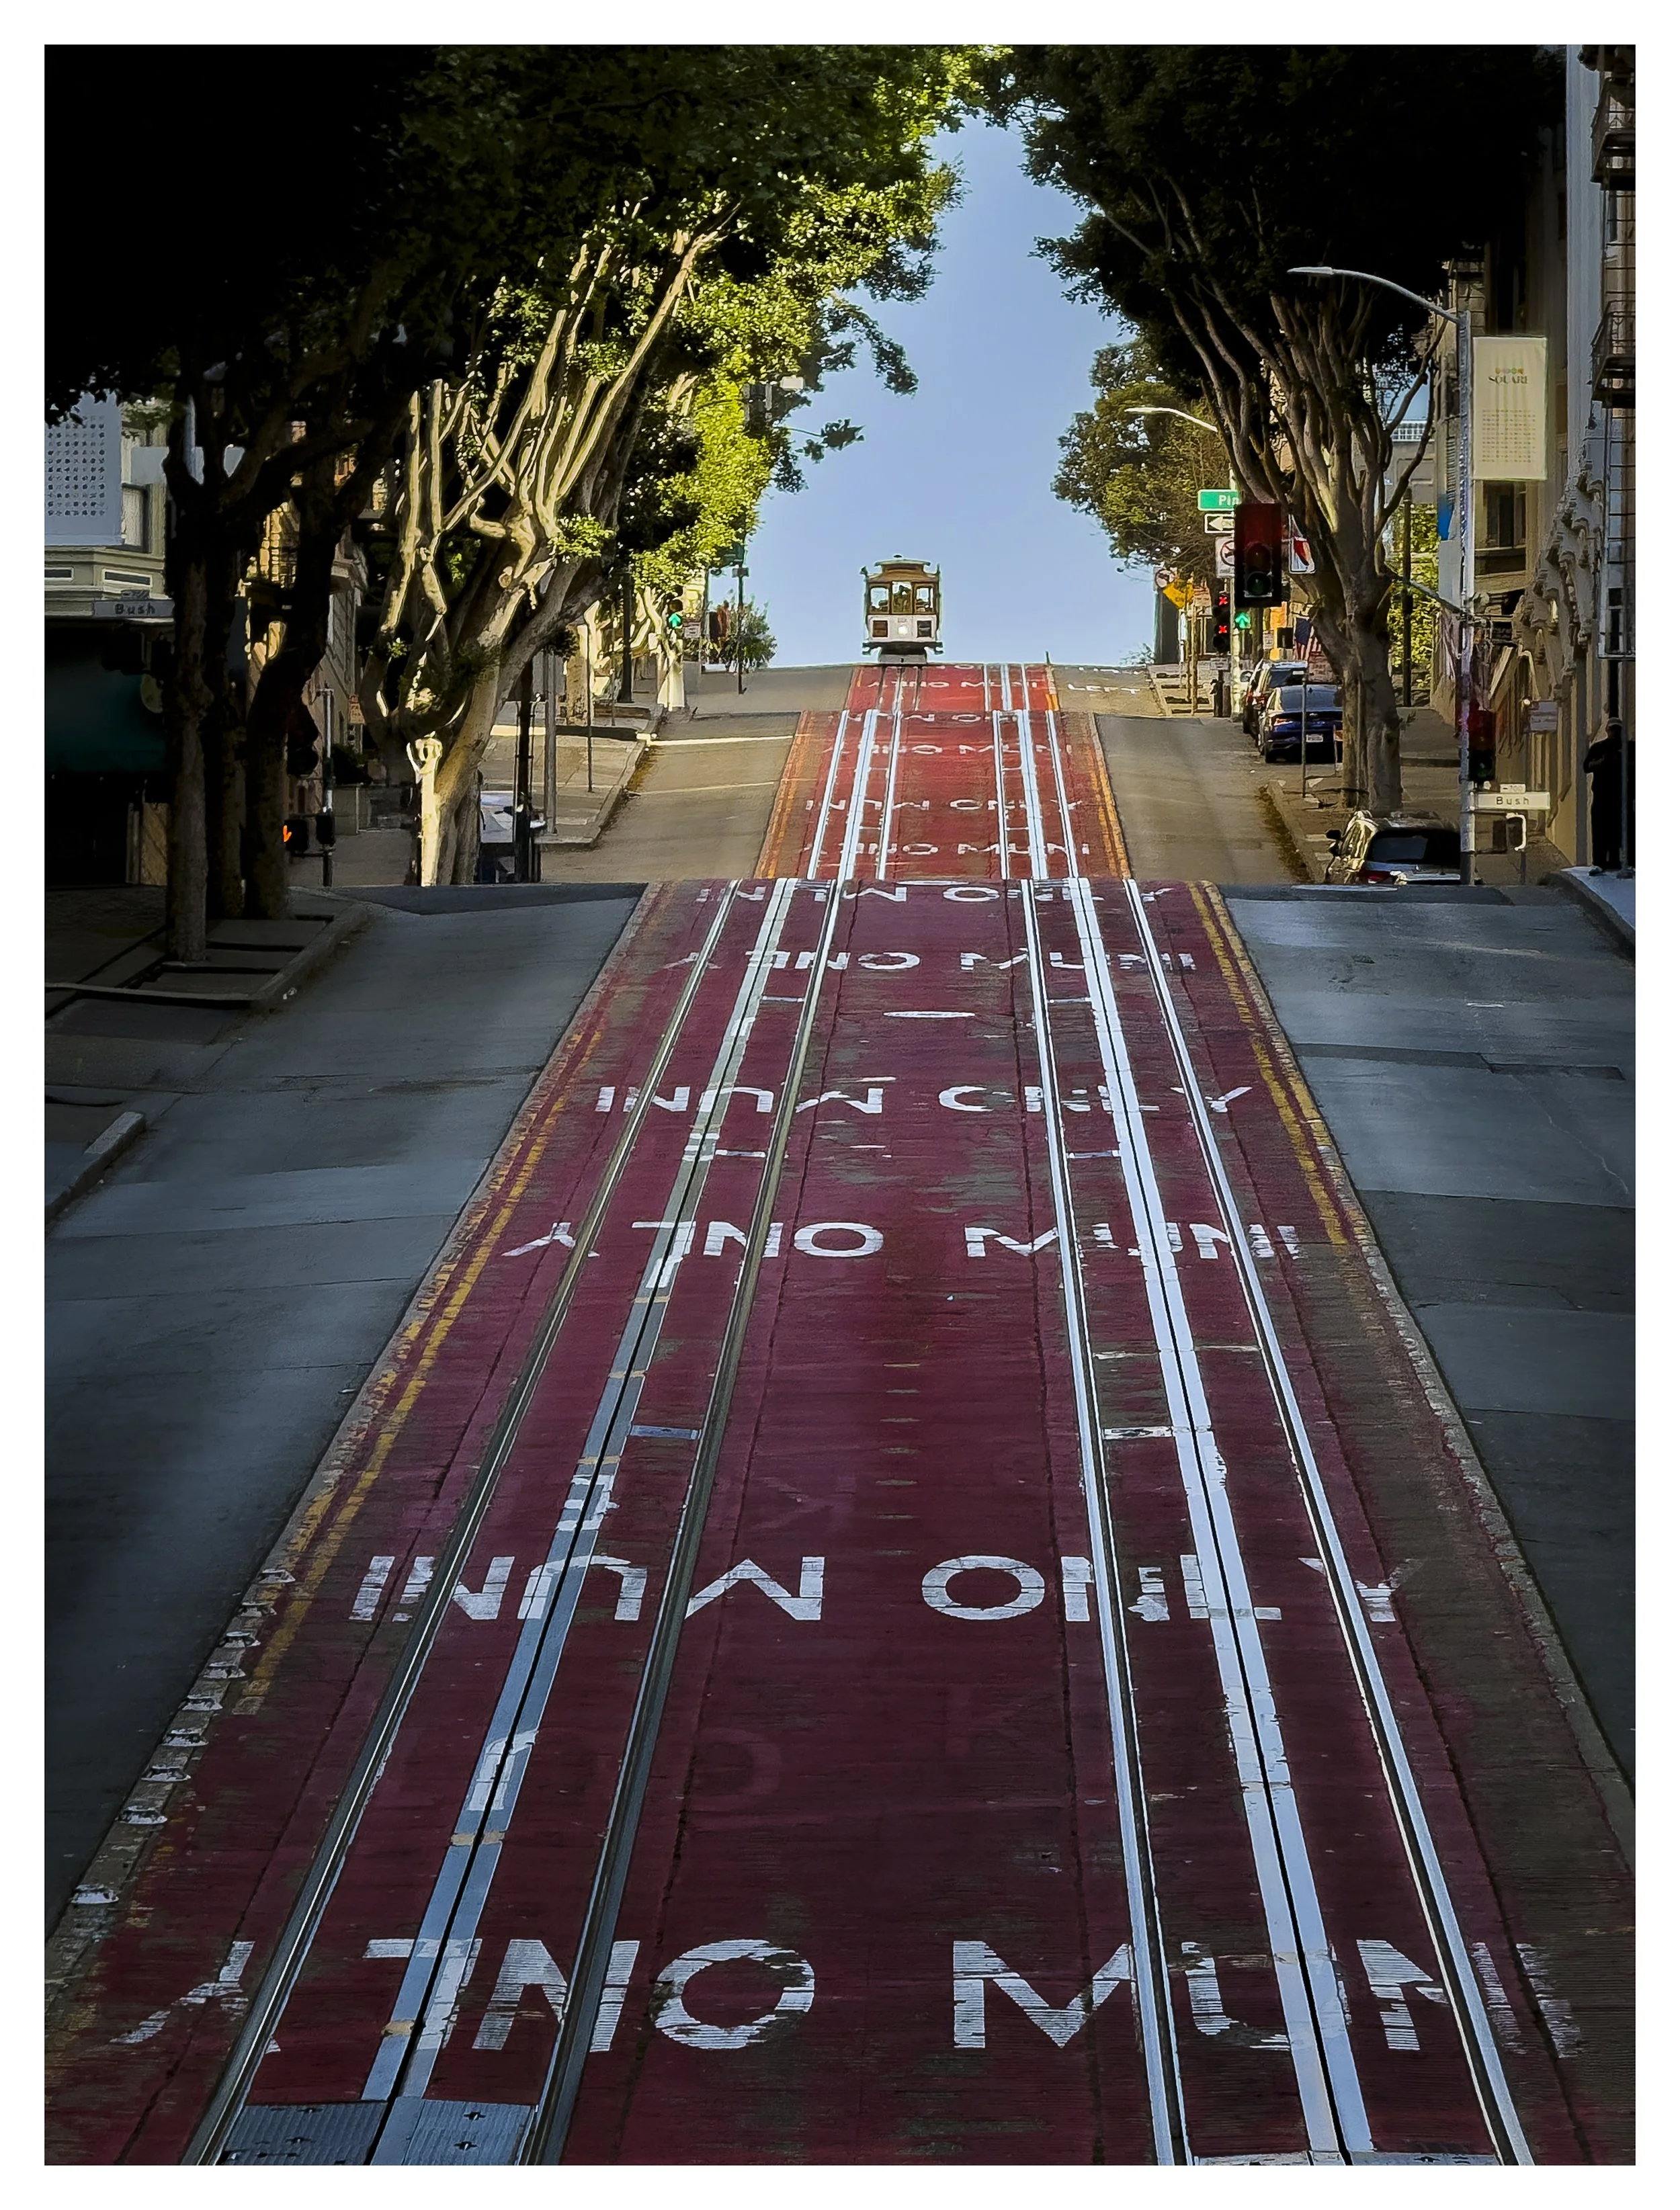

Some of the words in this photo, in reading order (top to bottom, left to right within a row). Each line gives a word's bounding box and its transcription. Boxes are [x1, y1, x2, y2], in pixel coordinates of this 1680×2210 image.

[1218, 495, 1240, 505] Pin
[114, 603, 155, 615] Bush
[1497, 796, 1529, 805] Bush
[501, 1222, 884, 1258] ONLY
[349, 1556, 825, 1621] MUNI
[106, 1938, 815, 2053] ONLY
[953, 1939, 1581, 2058] MUNI
